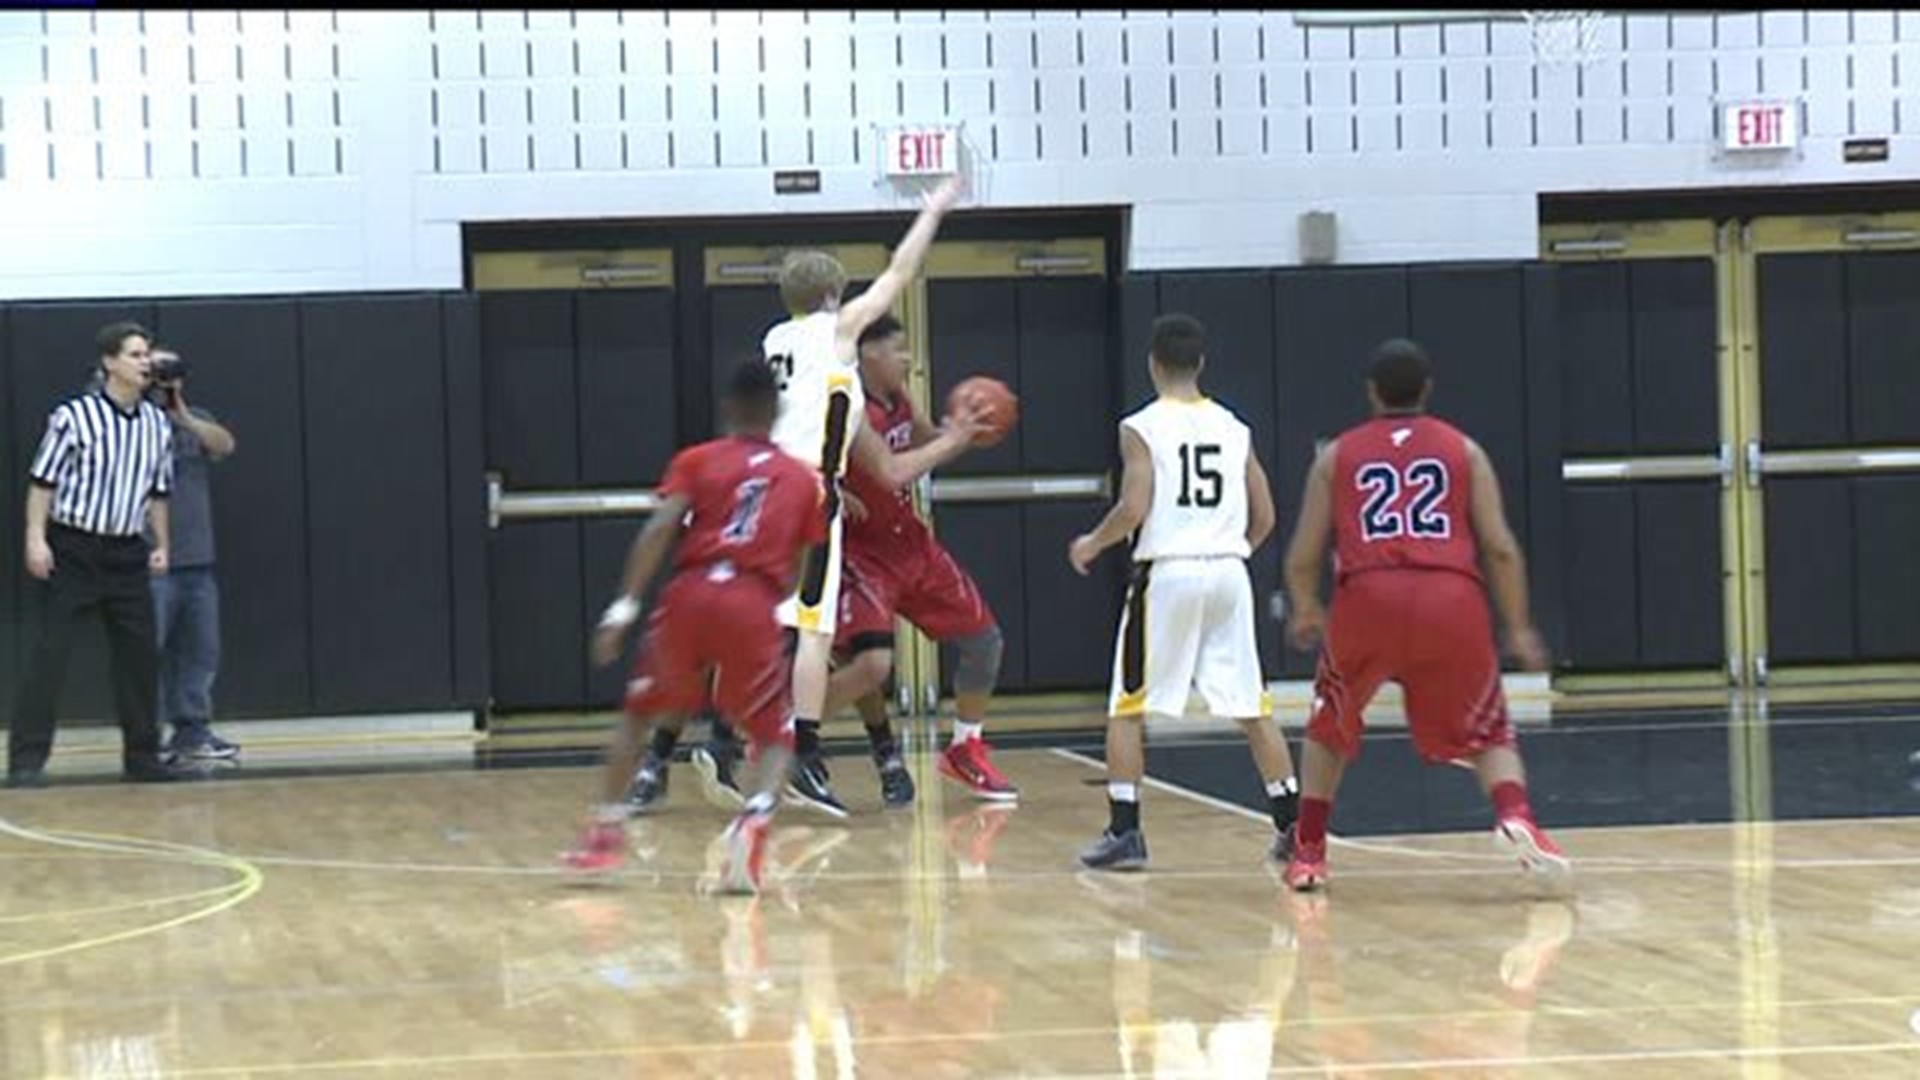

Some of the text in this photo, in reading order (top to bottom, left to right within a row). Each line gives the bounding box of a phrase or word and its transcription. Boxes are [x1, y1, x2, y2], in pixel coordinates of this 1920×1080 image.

[898, 133, 946, 170] EXIT
[1738, 108, 1784, 144] EXIT
[1176, 443, 1223, 508] 15
[1355, 458, 1450, 543] 22
[719, 476, 770, 544] 1
